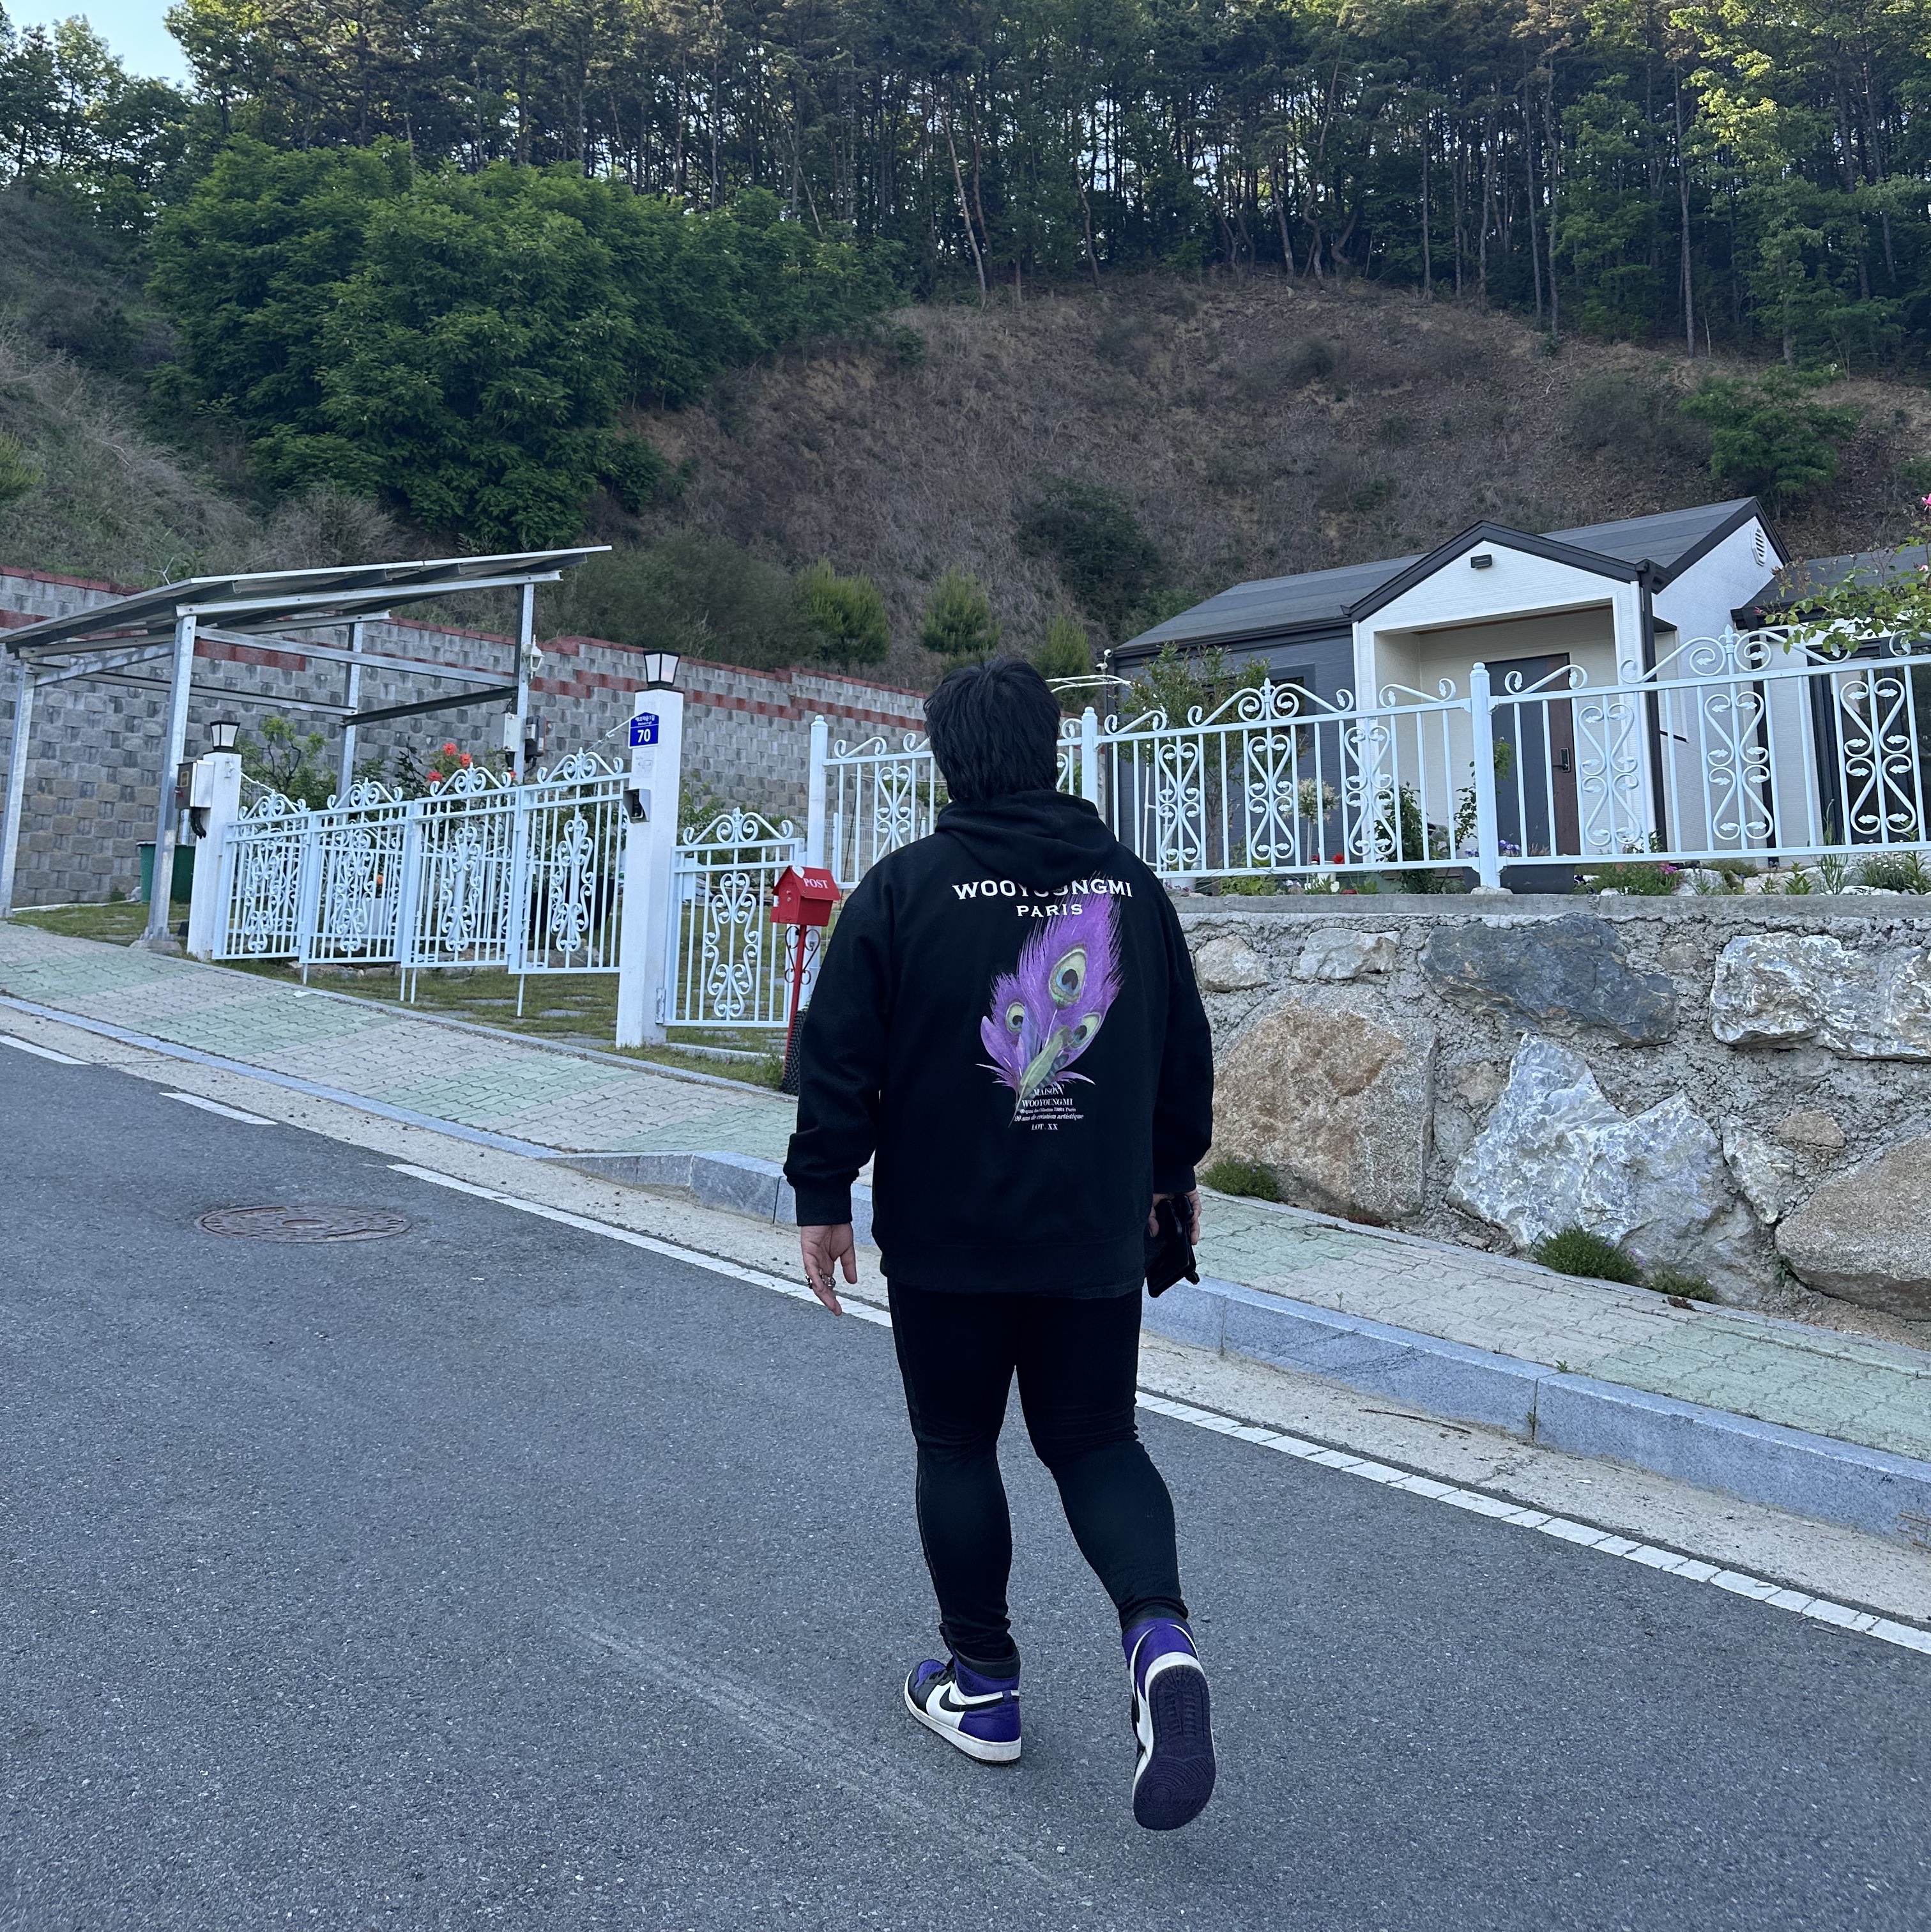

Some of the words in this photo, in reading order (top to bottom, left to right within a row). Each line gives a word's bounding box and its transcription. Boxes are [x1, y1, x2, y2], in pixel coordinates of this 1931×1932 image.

[637, 728, 651, 742] 70
[803, 878, 828, 889] POST
[1016, 904, 1083, 917] PARIS
[1022, 1098, 1073, 1107] WOOYOUNGMI
